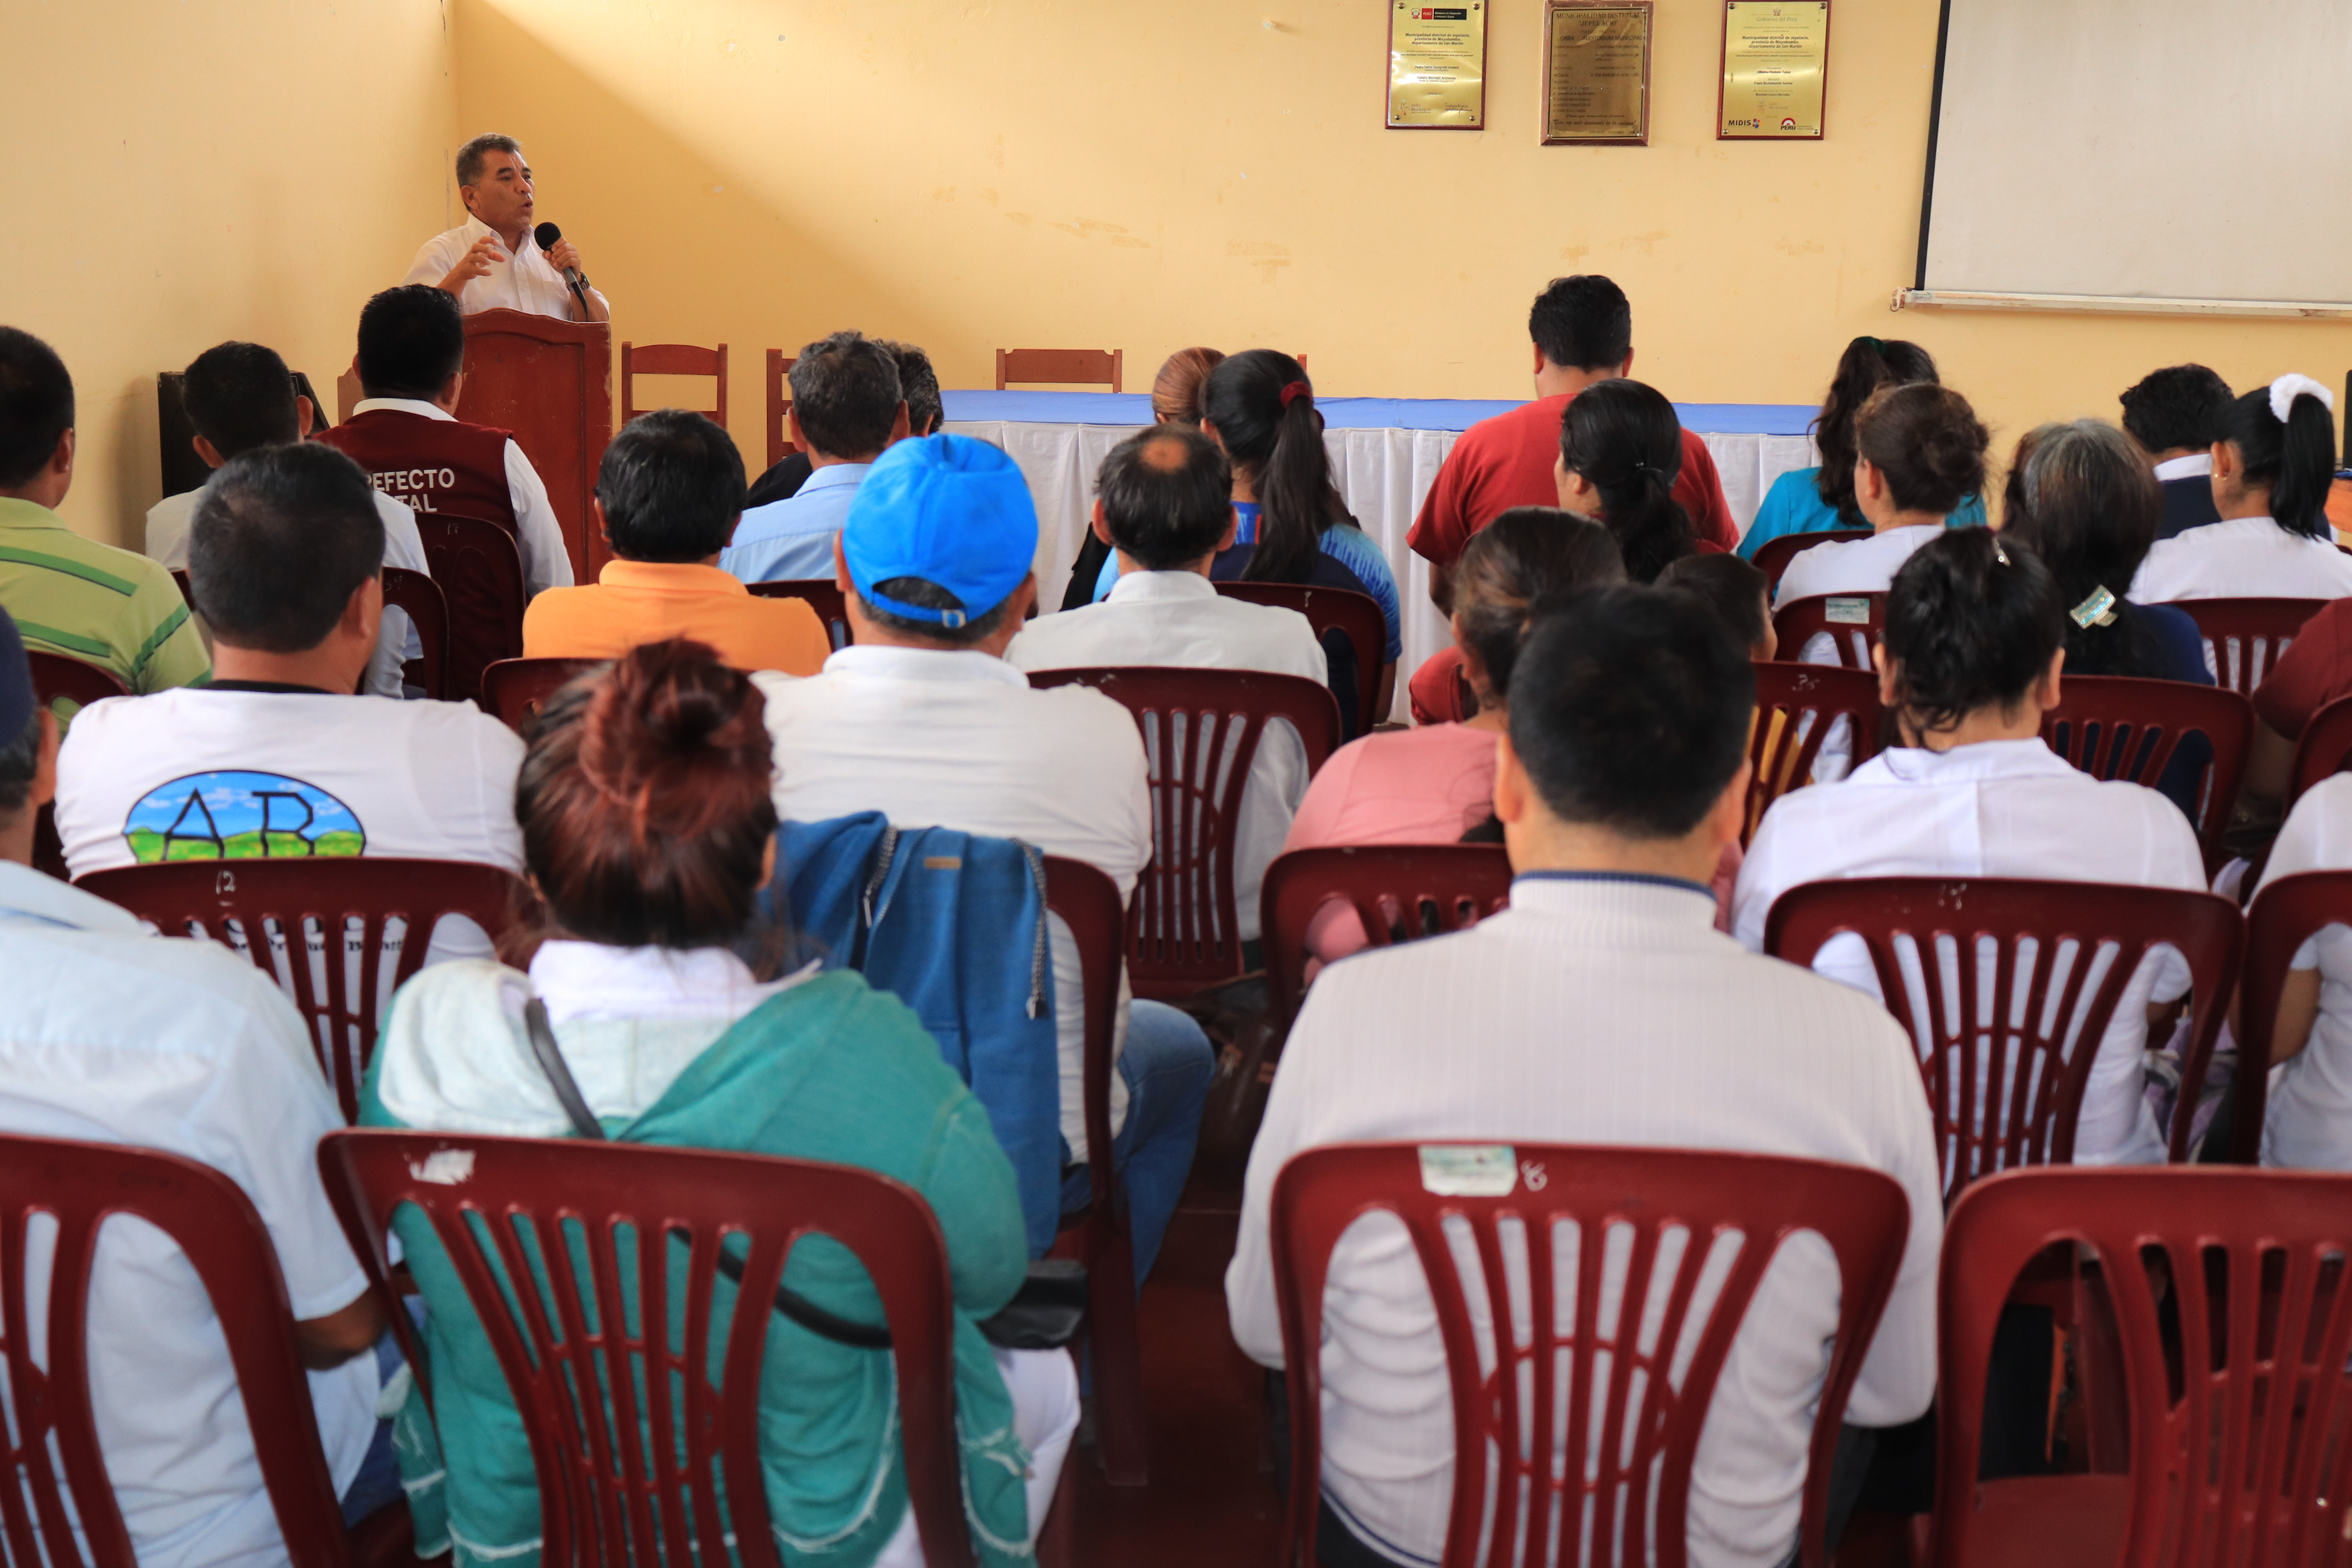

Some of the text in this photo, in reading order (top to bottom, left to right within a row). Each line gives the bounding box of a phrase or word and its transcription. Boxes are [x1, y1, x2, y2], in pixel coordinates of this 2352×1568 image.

[394, 494, 437, 512] TAL
[162, 787, 316, 861] AR
[216, 870, 236, 894] 12
